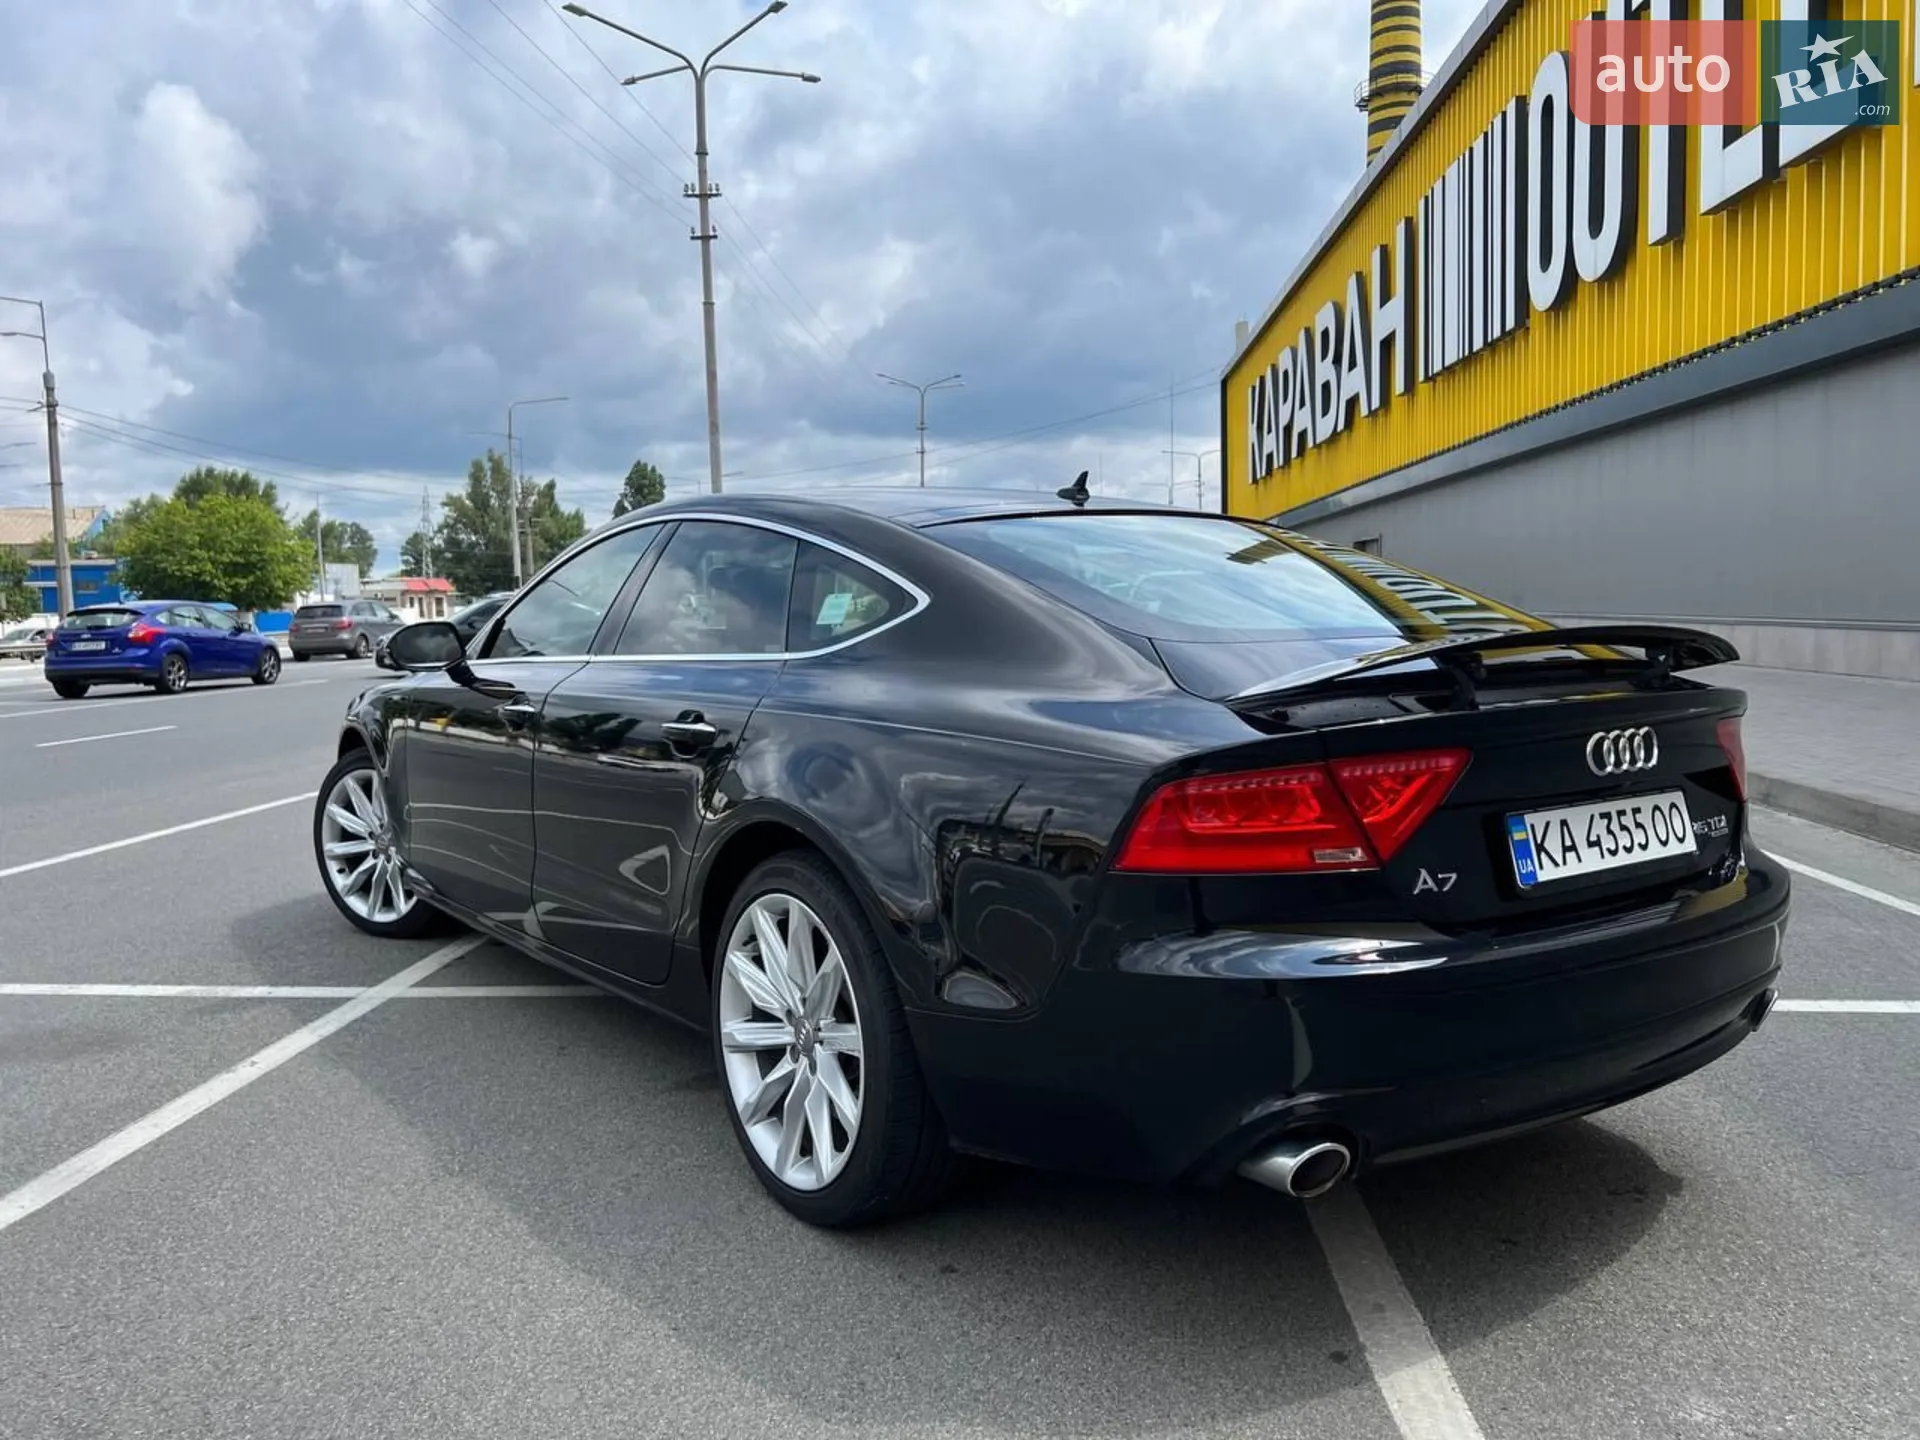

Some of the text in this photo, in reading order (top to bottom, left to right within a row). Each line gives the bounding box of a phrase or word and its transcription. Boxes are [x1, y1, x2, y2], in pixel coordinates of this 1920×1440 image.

[1248, 216, 1412, 485] КАРАВАН
[1529, 819, 1583, 871] KA
[1585, 806, 1650, 860] 4355
[1412, 867, 1458, 895] A7
[1518, 858, 1536, 874] UA
